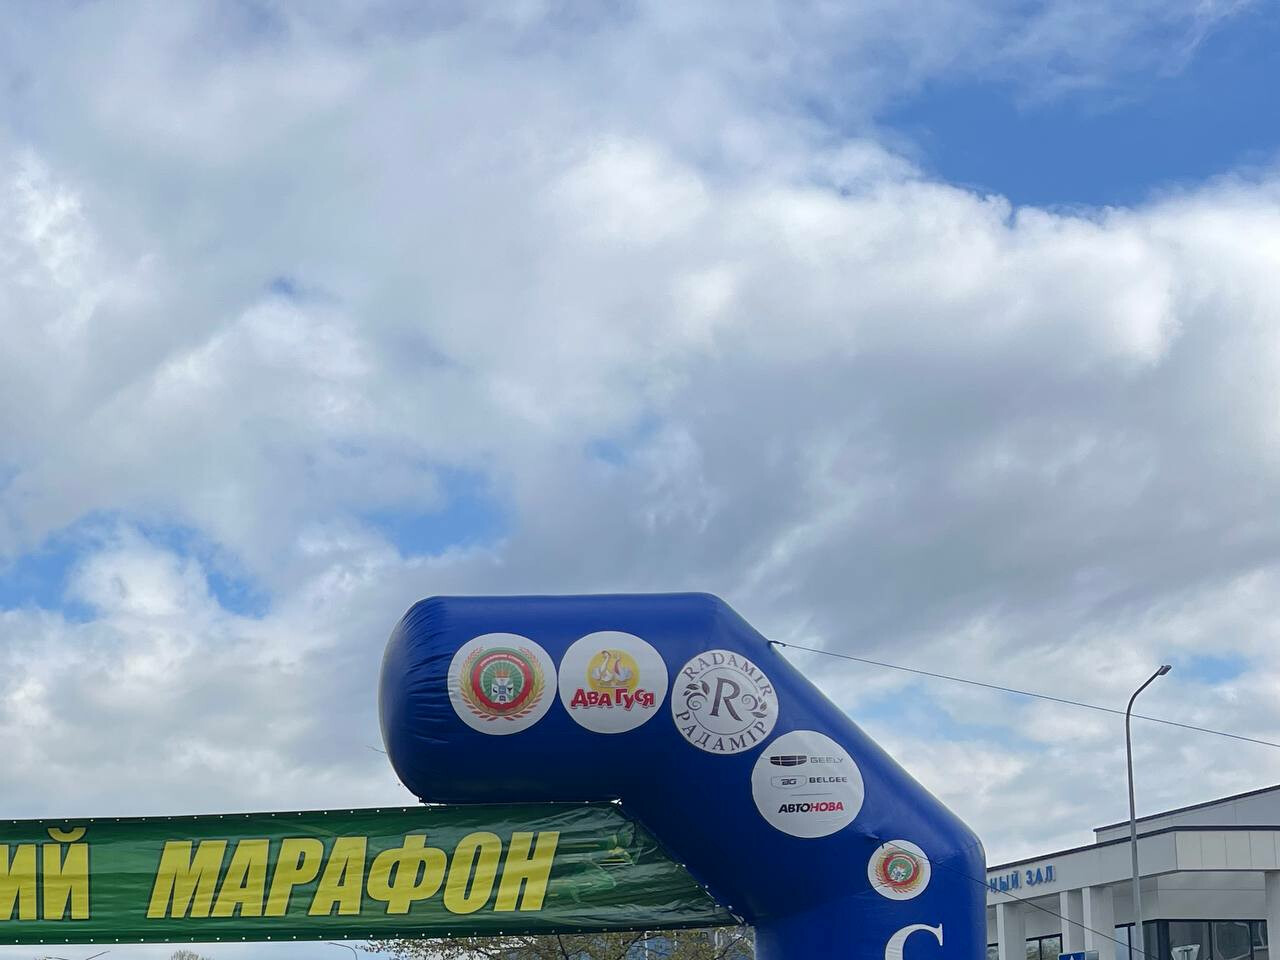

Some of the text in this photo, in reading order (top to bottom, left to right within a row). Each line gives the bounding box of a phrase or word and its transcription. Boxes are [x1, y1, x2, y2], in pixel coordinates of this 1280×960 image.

[682, 652, 773, 697] RADAMIR
[810, 756, 844, 764] GEELY
[809, 776, 848, 784] BELGEE
[778, 801, 845, 814] АВТОНОВА
[146, 830, 561, 919] МАРАФОН
[1025, 864, 1056, 886] ЗАЛ
